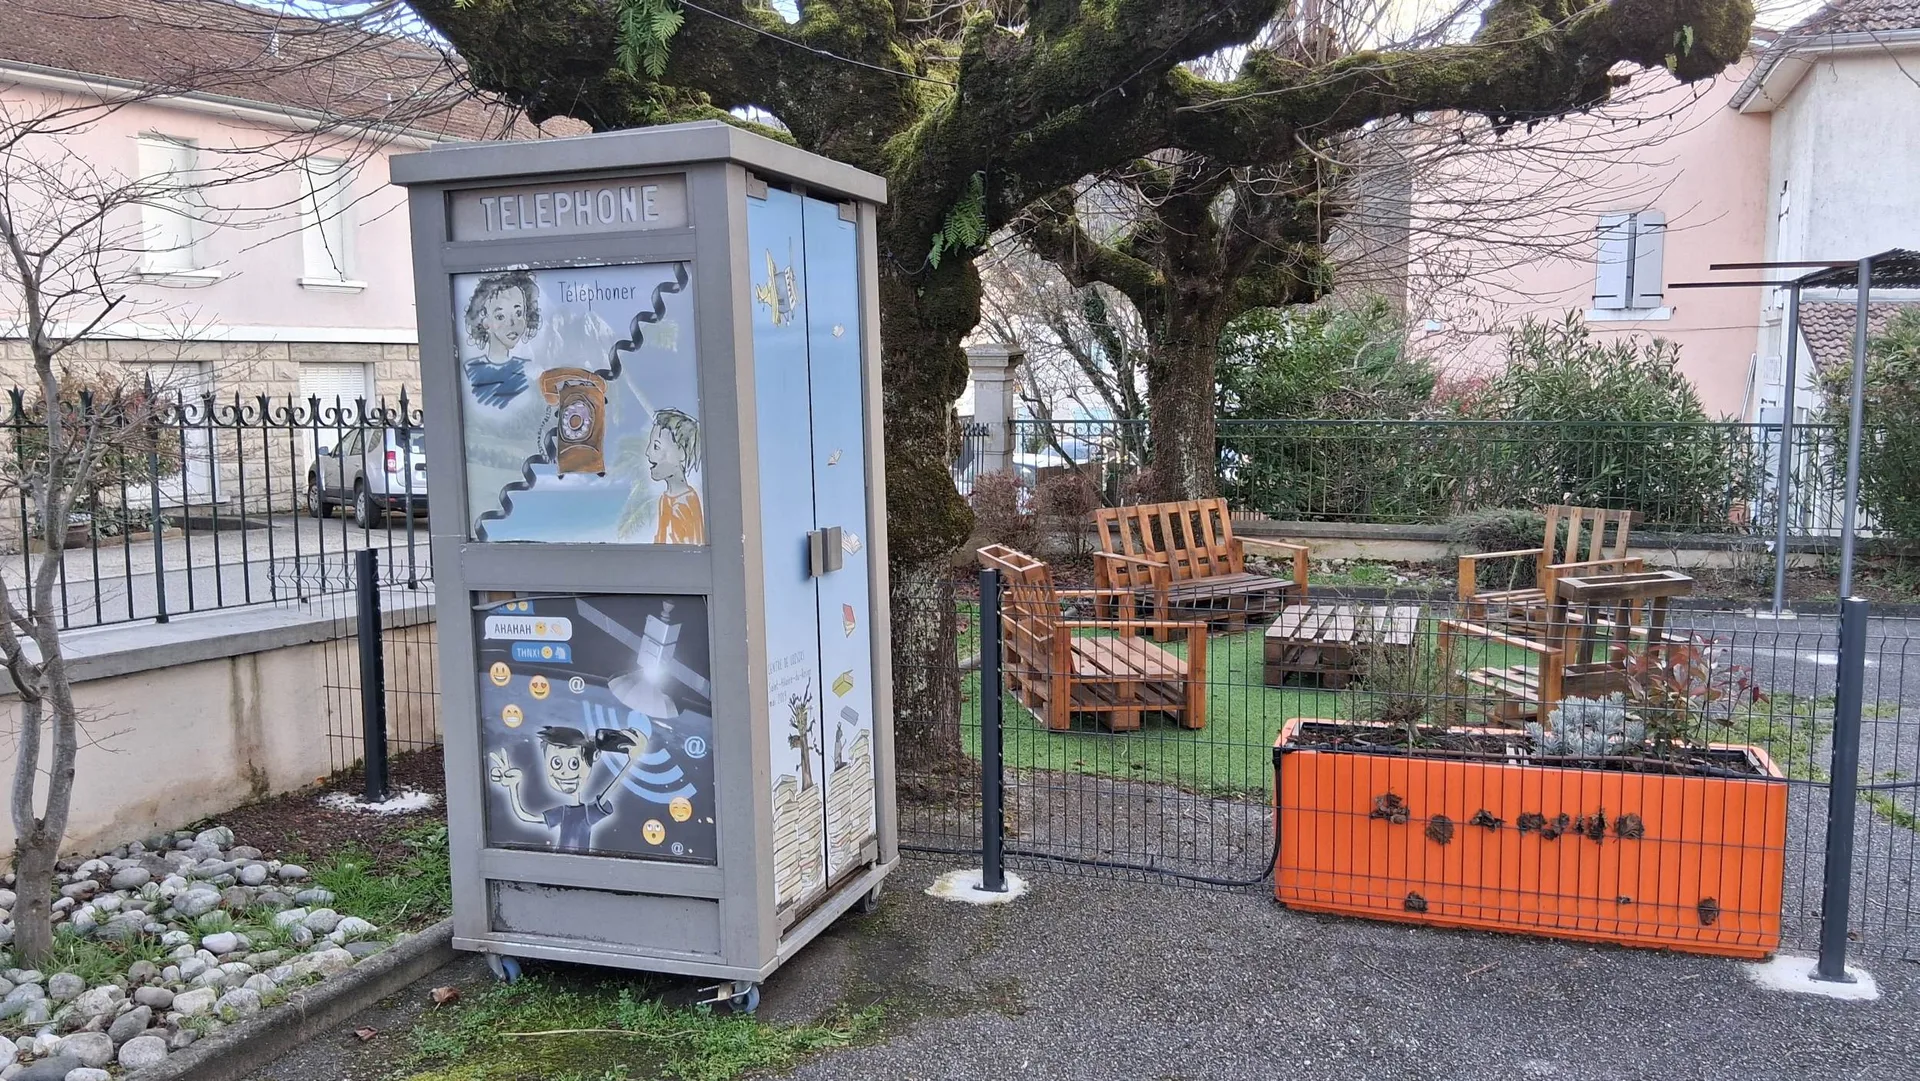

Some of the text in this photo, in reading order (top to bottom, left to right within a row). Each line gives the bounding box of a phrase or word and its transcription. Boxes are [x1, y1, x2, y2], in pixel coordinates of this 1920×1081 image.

[480, 186, 660, 231] TELEPHONE
[557, 279, 637, 311] Téléphoner
[494, 623, 532, 635] AHAHAH
